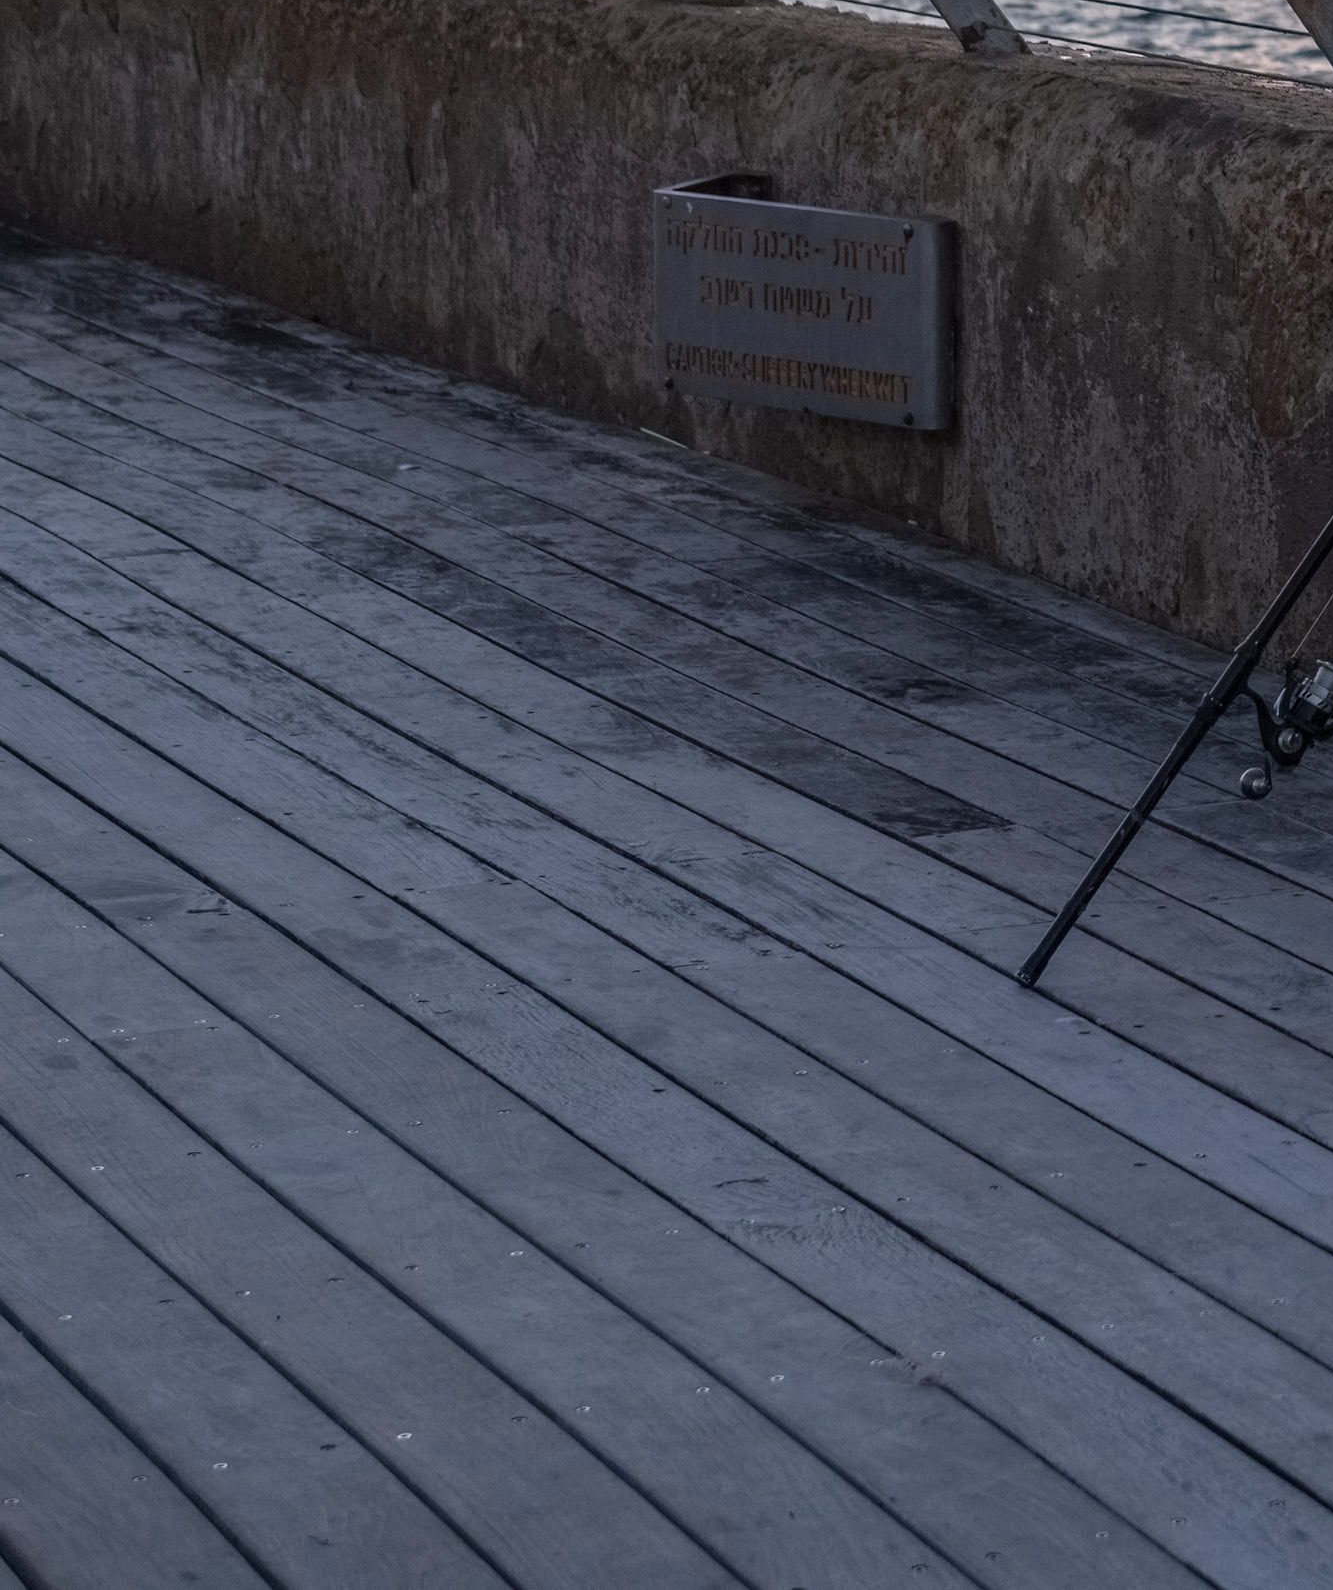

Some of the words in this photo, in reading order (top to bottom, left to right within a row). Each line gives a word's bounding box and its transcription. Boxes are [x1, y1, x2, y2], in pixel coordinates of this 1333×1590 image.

[841, 286, 873, 324] על
[820, 363, 870, 397] WHEN
[872, 371, 911, 405] WET
